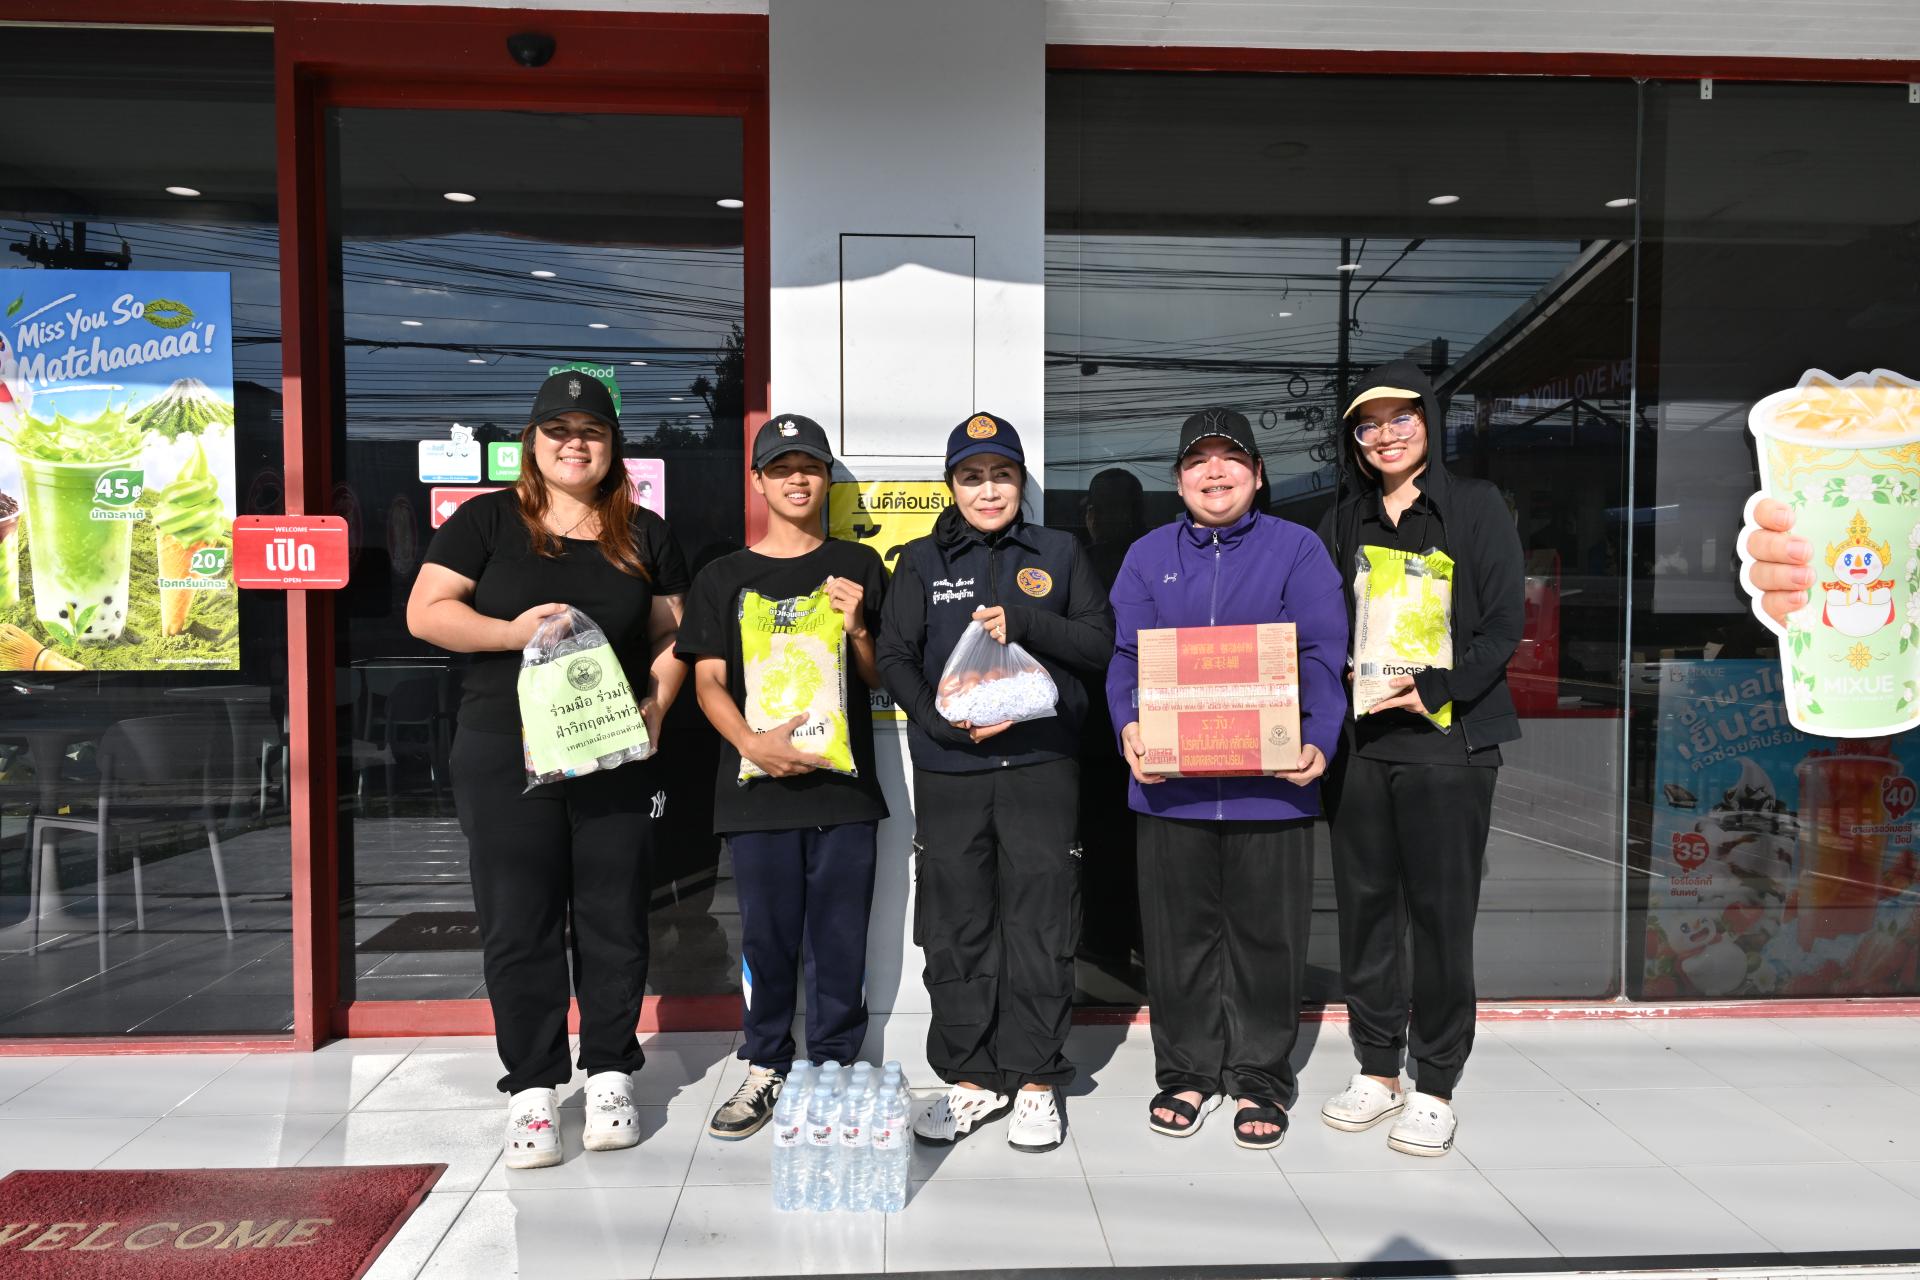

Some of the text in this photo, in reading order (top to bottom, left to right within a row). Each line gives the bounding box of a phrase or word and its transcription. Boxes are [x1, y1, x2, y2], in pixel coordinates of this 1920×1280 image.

[17, 294, 145, 353] Miss You So
[549, 365, 614, 378] GFood
[265, 537, 316, 572] เปิด
[1823, 674, 1895, 695] MIXUE
[550, 695, 593, 717] ร่วมมือ
[556, 704, 639, 739] ฝ่าวิกฤตน้ำท่ว
